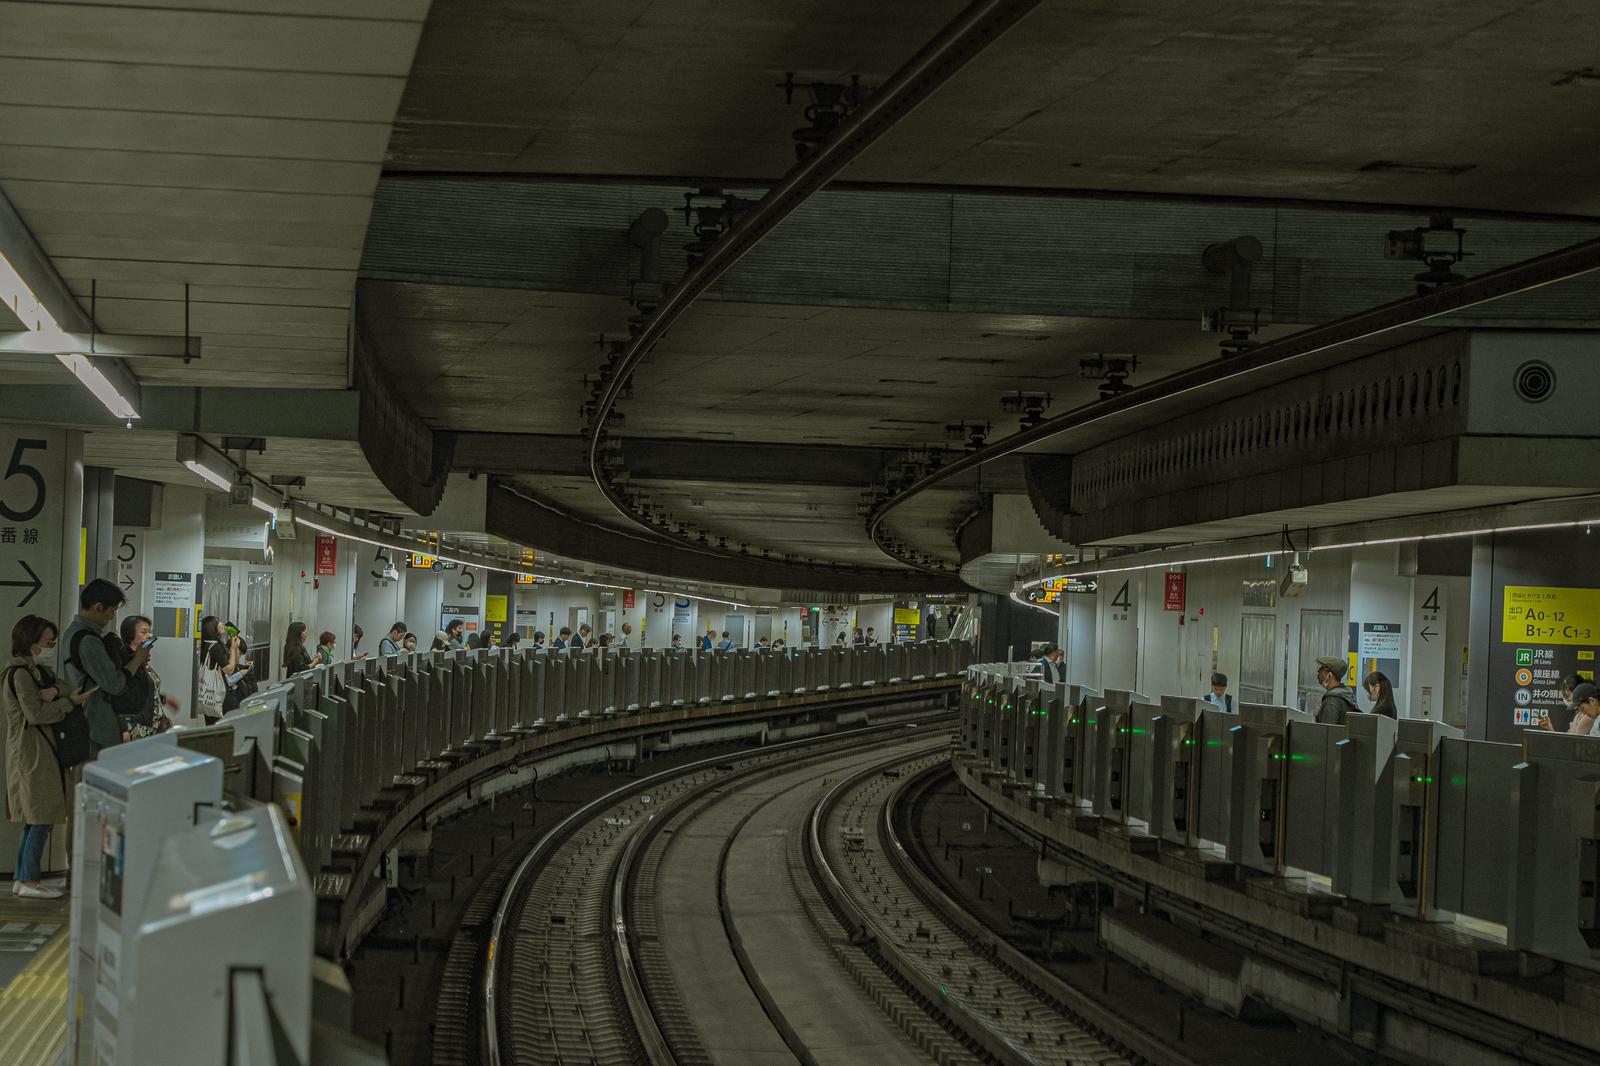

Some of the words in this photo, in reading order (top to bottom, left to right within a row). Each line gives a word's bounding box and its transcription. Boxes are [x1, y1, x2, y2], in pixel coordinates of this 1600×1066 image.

[0, 438, 47, 522] 5
[1, 527, 38, 544] 番線
[117, 534, 136, 561] 5
[371, 546, 389, 578] 5
[457, 565, 474, 591] 5
[1111, 578, 1132, 612] 4
[1421, 585, 1441, 613] 4
[1508, 606, 1523, 614] 出口
[1533, 649, 1554, 659] JR線
[1533, 669, 1560, 679] 銀座線
[1517, 691, 1529, 701] IN
